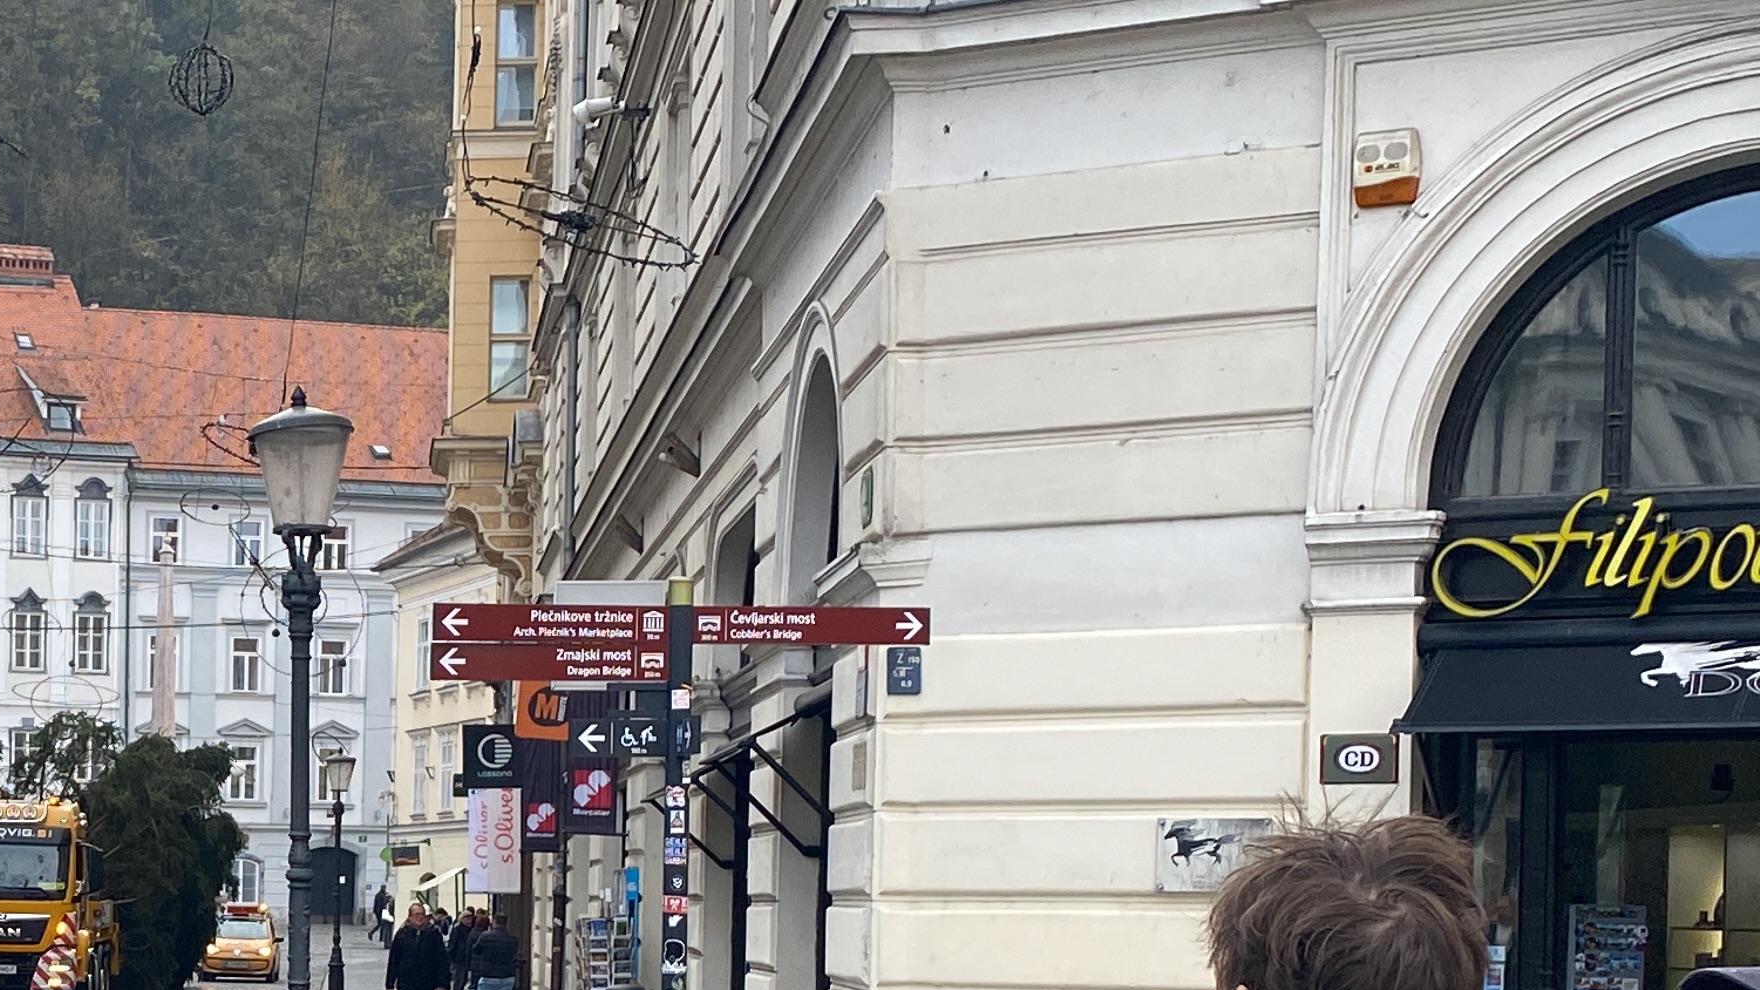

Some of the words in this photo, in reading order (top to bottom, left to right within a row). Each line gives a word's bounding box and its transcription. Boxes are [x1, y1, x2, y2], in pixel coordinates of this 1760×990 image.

[1432, 489, 1760, 619] Filipo
[530, 609, 591, 624] Plečnikove
[594, 609, 634, 623] tržnice
[730, 609, 784, 626] Čevljarski
[786, 612, 816, 625] most
[513, 626, 537, 637] Arch.
[538, 626, 576, 638] Plečnik's
[578, 626, 633, 639] Marketplace
[729, 628, 771, 640] Cobbler's
[773, 629, 803, 641] Bridge
[556, 648, 600, 663] Zmajski
[602, 650, 632, 661] most
[567, 665, 601, 677] Dragon
[602, 665, 632, 677] Bridge
[1344, 750, 1374, 769] CD
